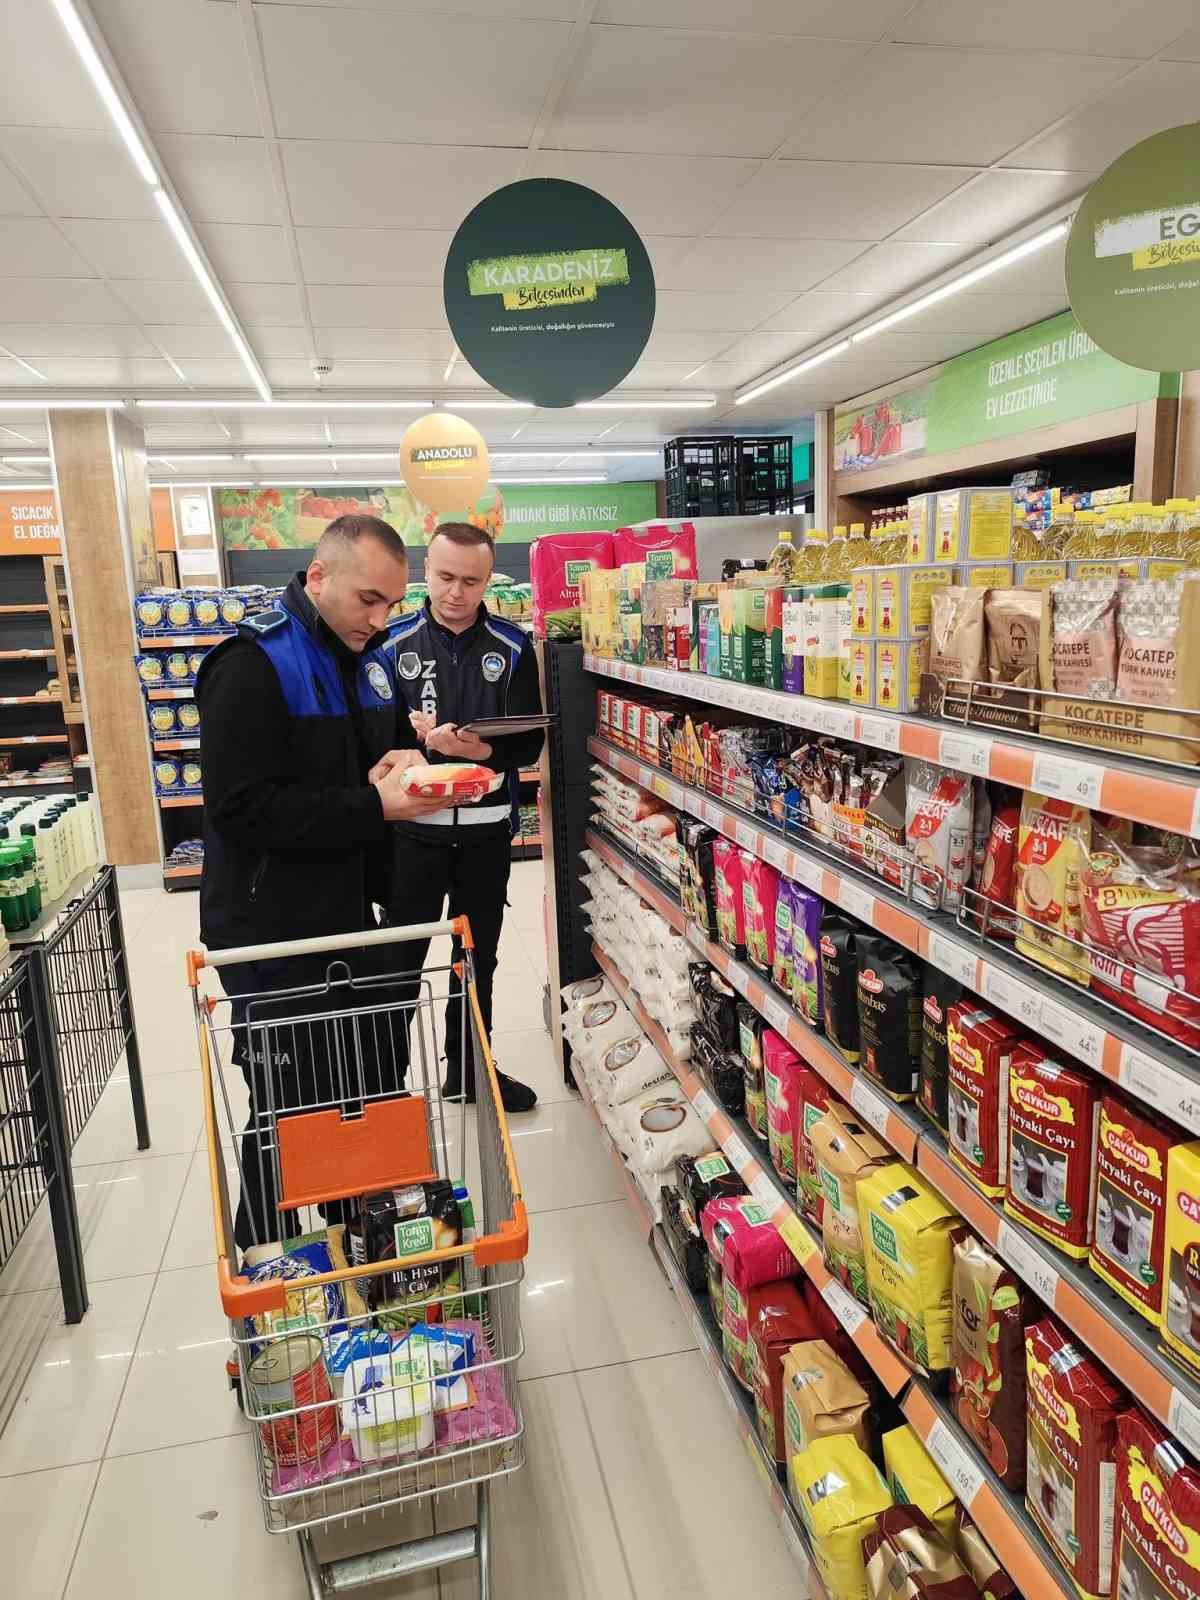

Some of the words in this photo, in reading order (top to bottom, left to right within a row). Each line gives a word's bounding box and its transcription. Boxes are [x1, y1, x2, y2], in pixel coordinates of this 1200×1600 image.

[483, 255, 615, 287] KARADENİZ
[518, 284, 585, 307] Bölgesinden
[988, 356, 1023, 387] ÖZENLE
[1024, 336, 1067, 374] SEÇİLEN
[416, 447, 472, 460] ANADOLU
[11, 506, 55, 521] SICACIK
[503, 507, 546, 524] LINDAKİ
[548, 504, 570, 522] GİBİ
[571, 505, 618, 521] KATKISIZ
[15, 527, 28, 539] EL
[30, 524, 62, 539] DEĞM
[1051, 642, 1091, 656] OCATEPE
[1118, 646, 1179, 664] OCATEP
[1140, 667, 1177, 680] KAHVES
[420, 660, 438, 717] ZAB
[1065, 705, 1144, 729] KOCATEPE
[1010, 1106, 1042, 1136] Tiryaki
[1045, 1128, 1075, 1149] Çayı
[1098, 1150, 1131, 1187] Tiryaki
[1134, 1180, 1162, 1206] Çayı
[1179, 1194, 1200, 1222] ÇA
[400, 1225, 430, 1239] Tarım
[403, 1233, 429, 1249] Kredi
[412, 1265, 439, 1280] Hasa
[409, 1280, 431, 1296] Çay
